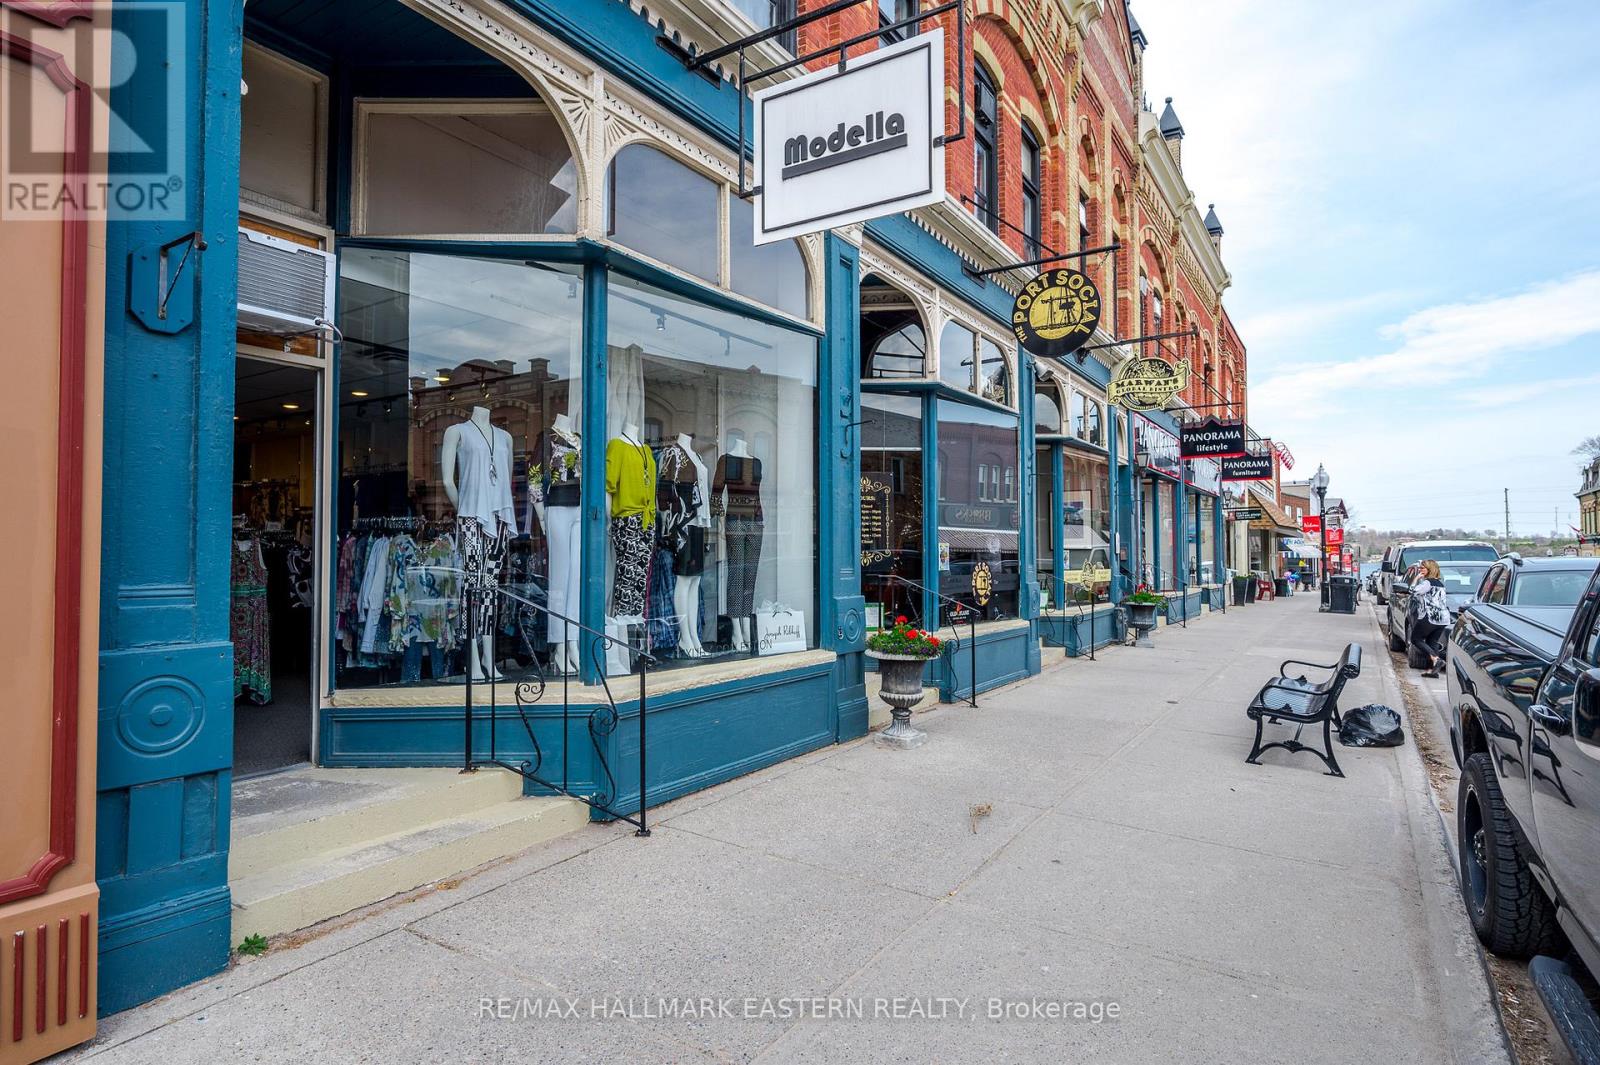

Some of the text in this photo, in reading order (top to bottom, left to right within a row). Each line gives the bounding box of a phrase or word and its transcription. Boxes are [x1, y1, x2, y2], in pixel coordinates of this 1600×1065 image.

[1013, 270, 1098, 343] THE PORT SOCIAL
[1183, 430, 1241, 442] PANORAMA
[1196, 443, 1228, 453] lifestyle
[1223, 460, 1270, 469] PANORAMA
